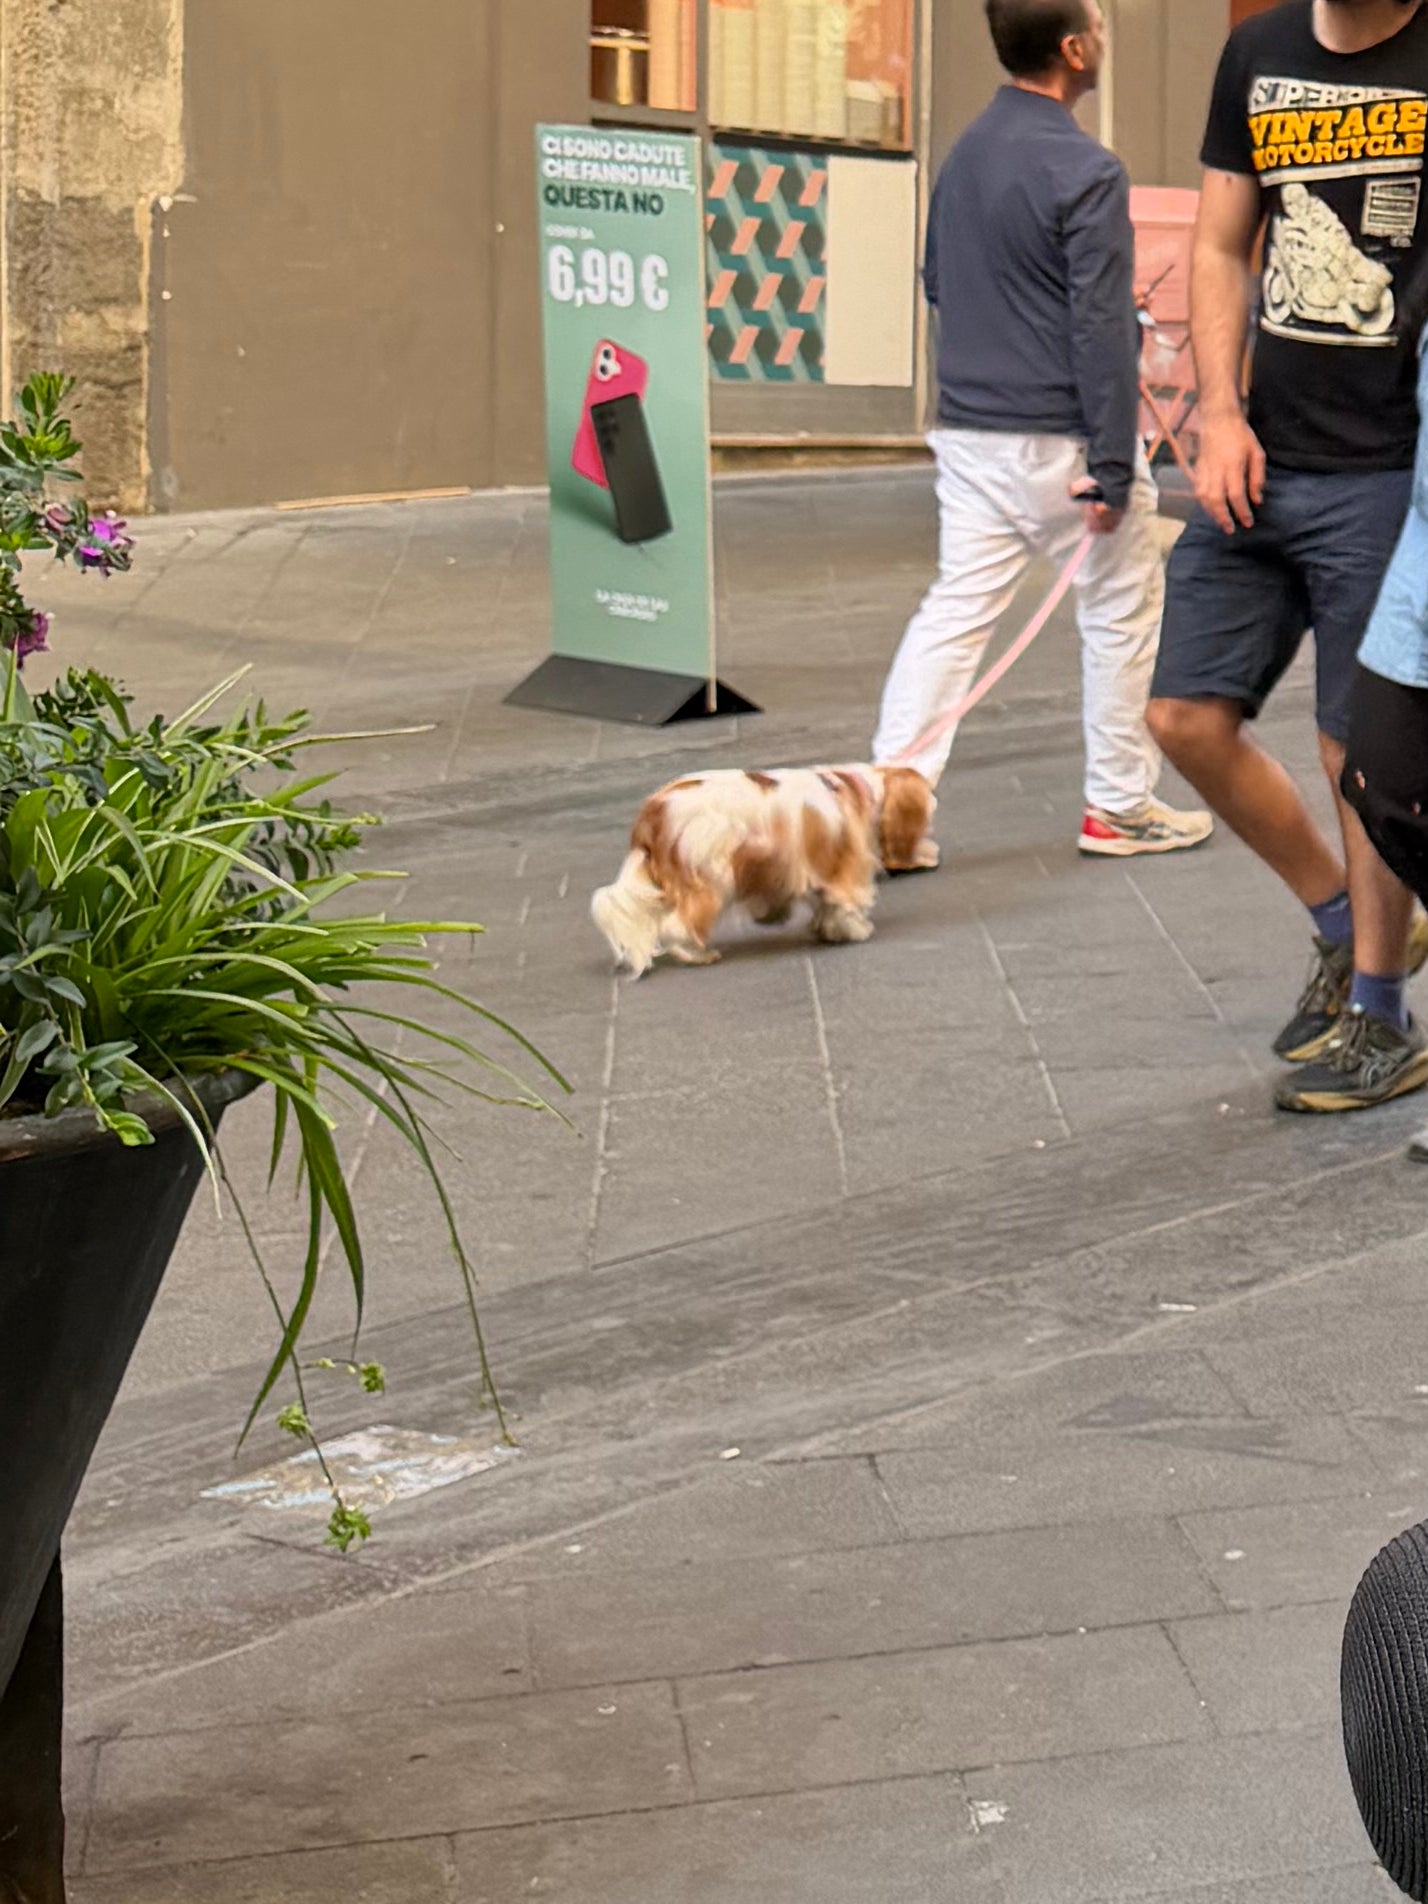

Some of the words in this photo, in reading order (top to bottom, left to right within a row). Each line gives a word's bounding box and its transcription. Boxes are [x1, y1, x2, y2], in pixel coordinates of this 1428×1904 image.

[1248, 99, 1428, 146] VINTAGE
[542, 157, 581, 180] CHE
[613, 140, 685, 166] CADUTE
[1251, 132, 1426, 171] MOTORCYCLE
[544, 183, 628, 213] QUESTA
[633, 192, 664, 216] NO
[548, 244, 635, 309] 6,99
[640, 253, 670, 312] €
